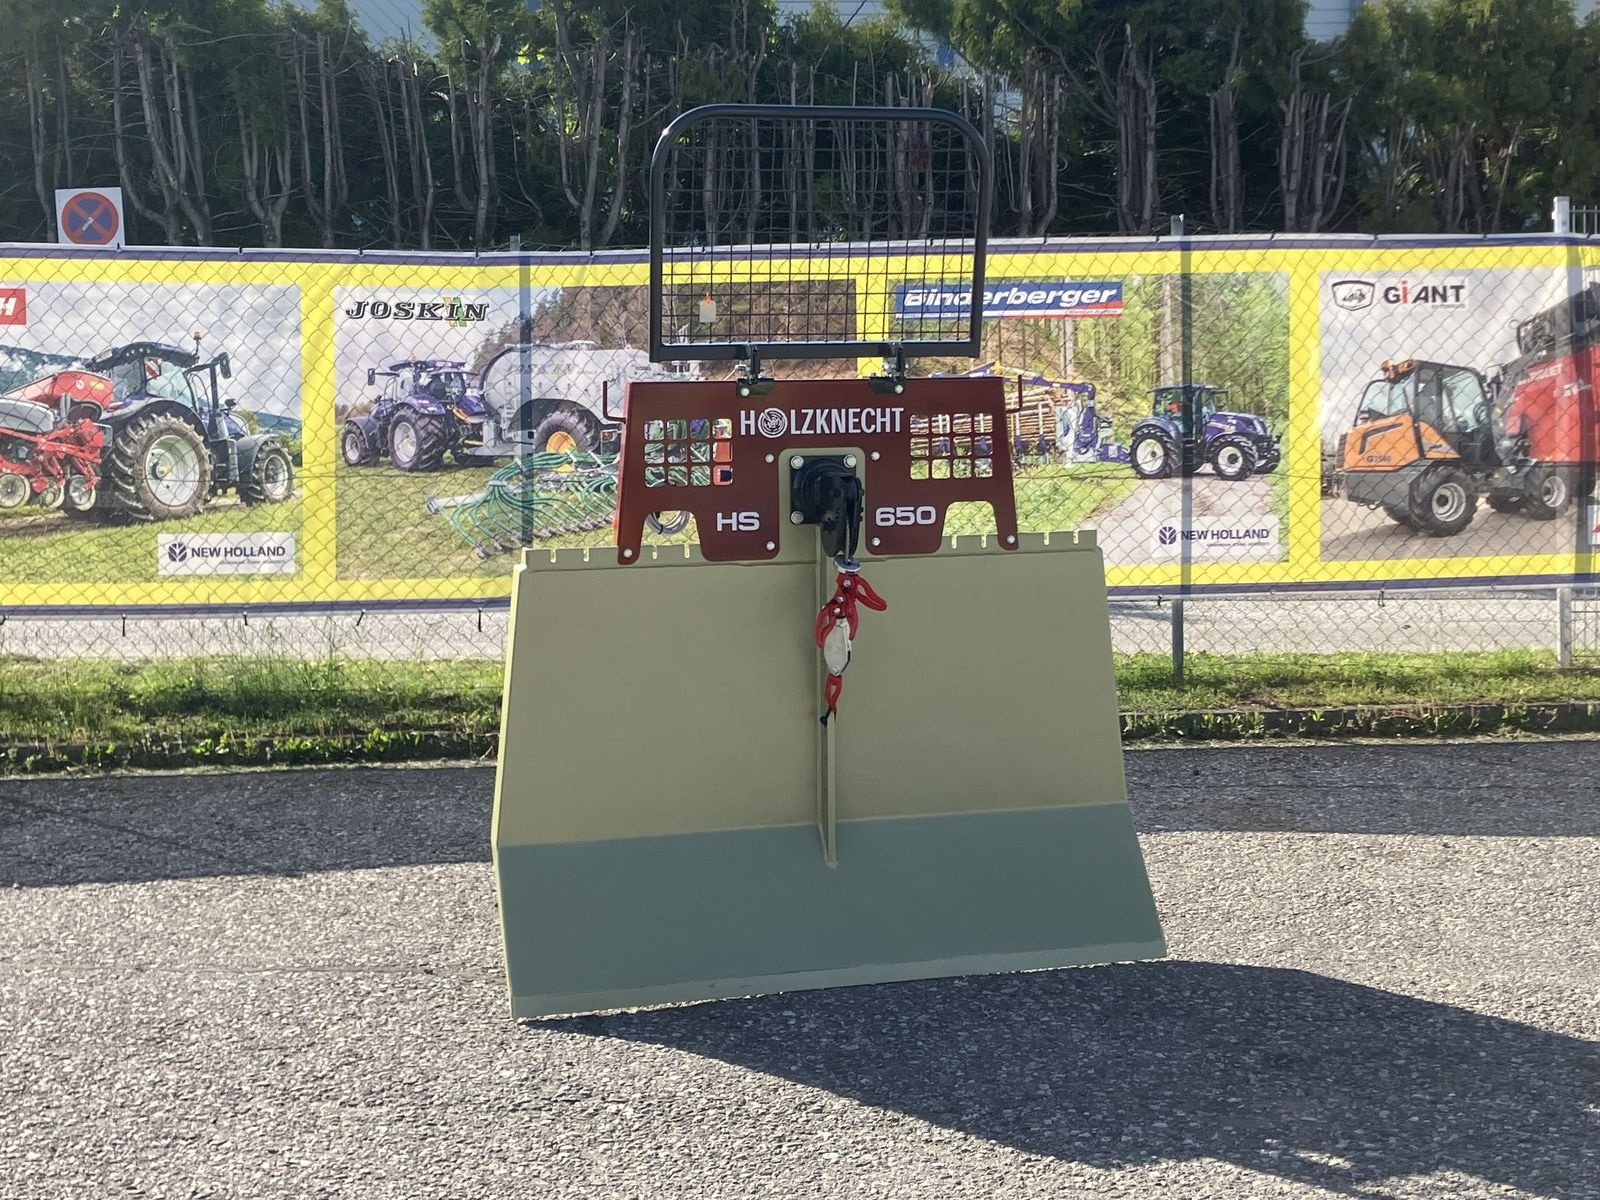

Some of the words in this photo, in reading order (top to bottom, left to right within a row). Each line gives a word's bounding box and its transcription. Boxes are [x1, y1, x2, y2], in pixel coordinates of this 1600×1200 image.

[345, 300, 490, 321] JOSKIN
[740, 407, 905, 439] HOLZKNECHT
[717, 511, 760, 532] HS
[875, 506, 937, 527] 650
[1181, 530, 1209, 540] NEW
[1211, 528, 1270, 540] HOLLAND
[192, 547, 221, 558] NEW
[224, 546, 286, 557] HOLLAND
